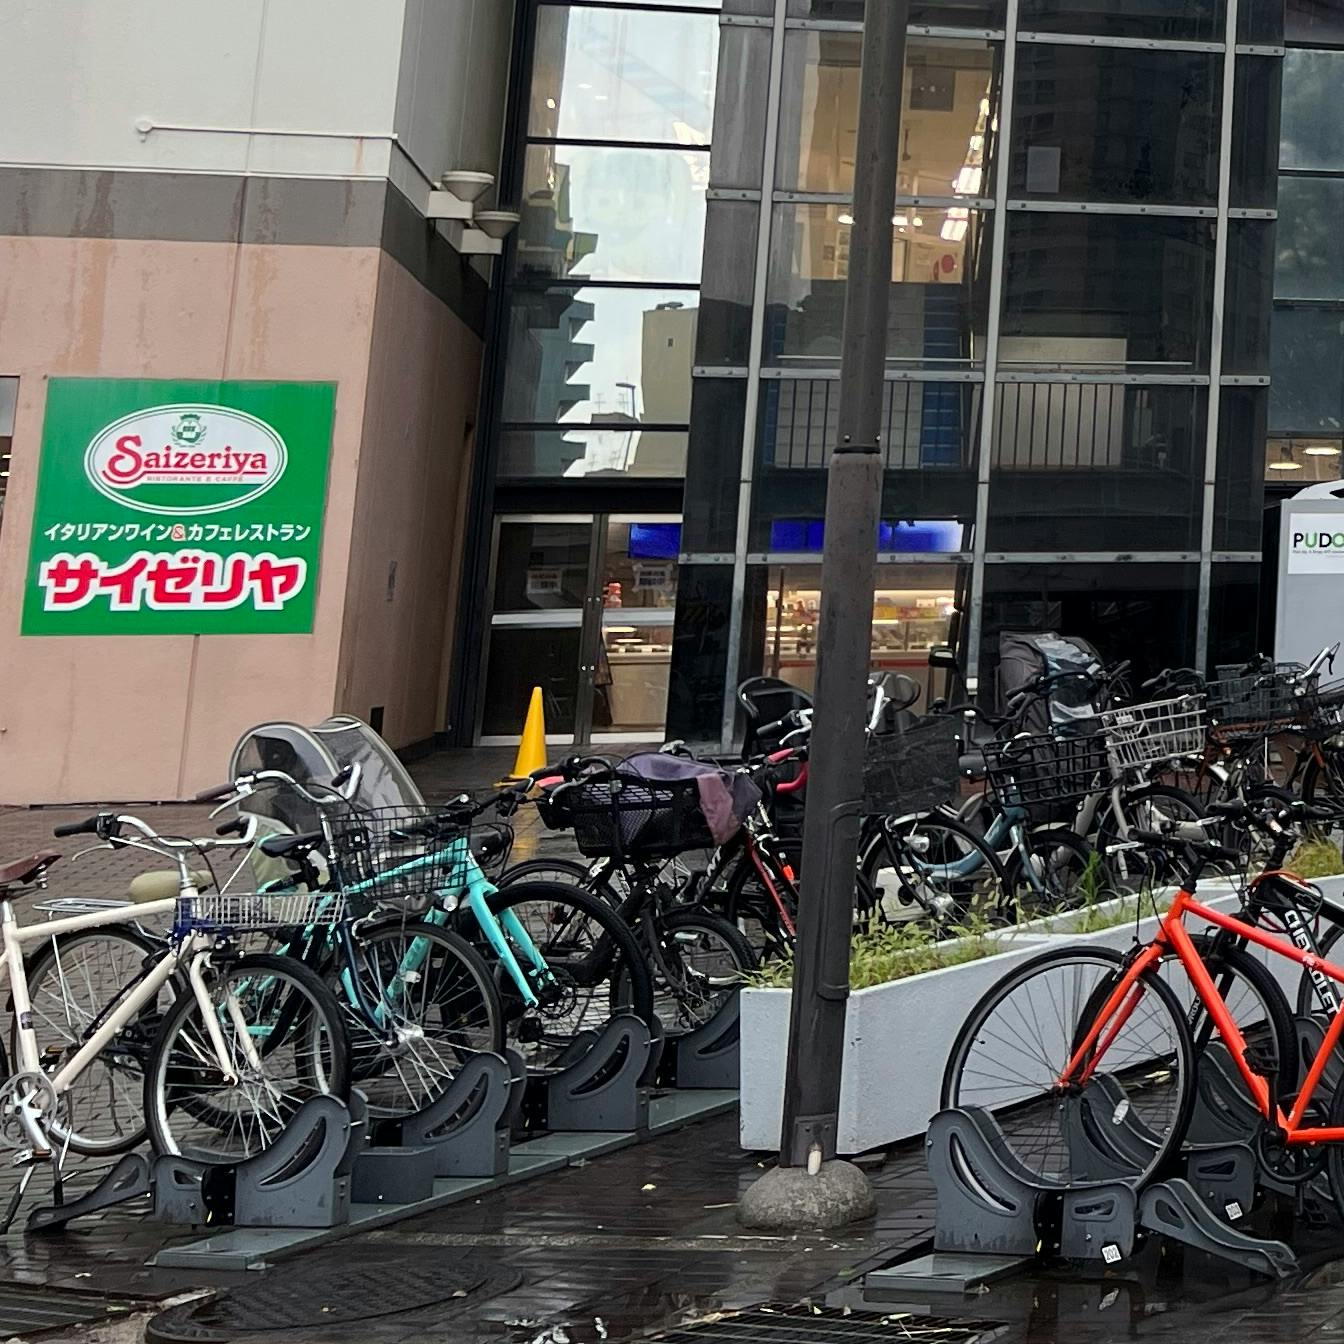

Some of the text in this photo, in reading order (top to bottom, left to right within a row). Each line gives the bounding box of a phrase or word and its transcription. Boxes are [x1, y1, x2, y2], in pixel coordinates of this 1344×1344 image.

[105, 435, 268, 479] Saizeriya
[44, 524, 312, 542] イタリアンワイン&カフェレストラン
[46, 555, 300, 605] サイゼリヤ
[1284, 909, 1341, 1015] CHEOLET
